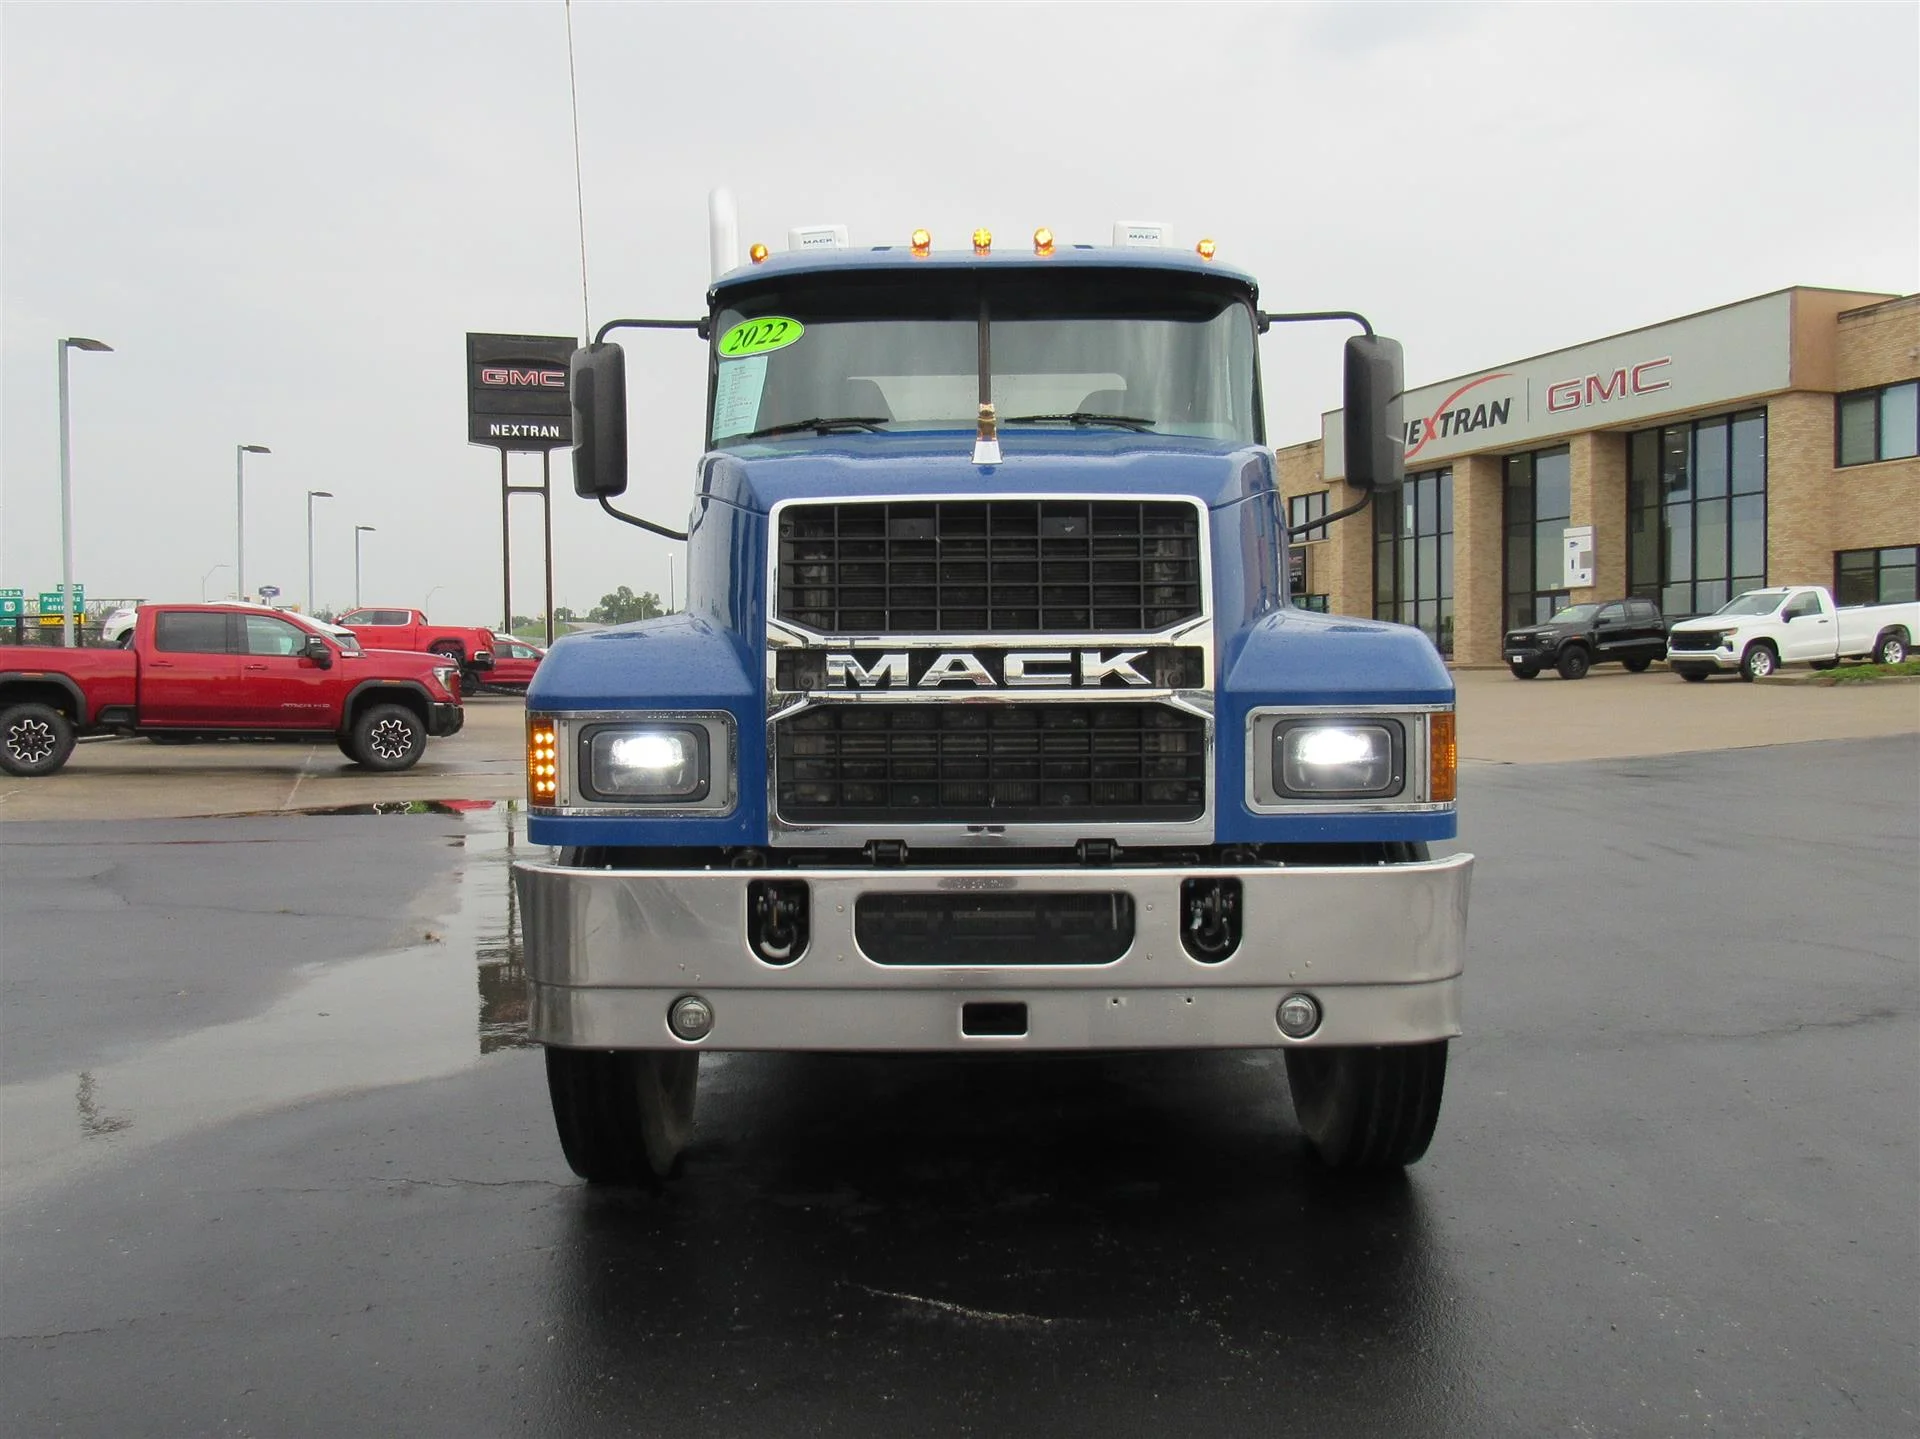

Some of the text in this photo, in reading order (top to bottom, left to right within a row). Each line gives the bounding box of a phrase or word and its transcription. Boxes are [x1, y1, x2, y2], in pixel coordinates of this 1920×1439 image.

[728, 321, 789, 352] 2022
[481, 368, 566, 388] GMC
[1545, 355, 1673, 415] GMC
[490, 424, 560, 438] NEXTRAN
[826, 651, 1152, 687] MACK
